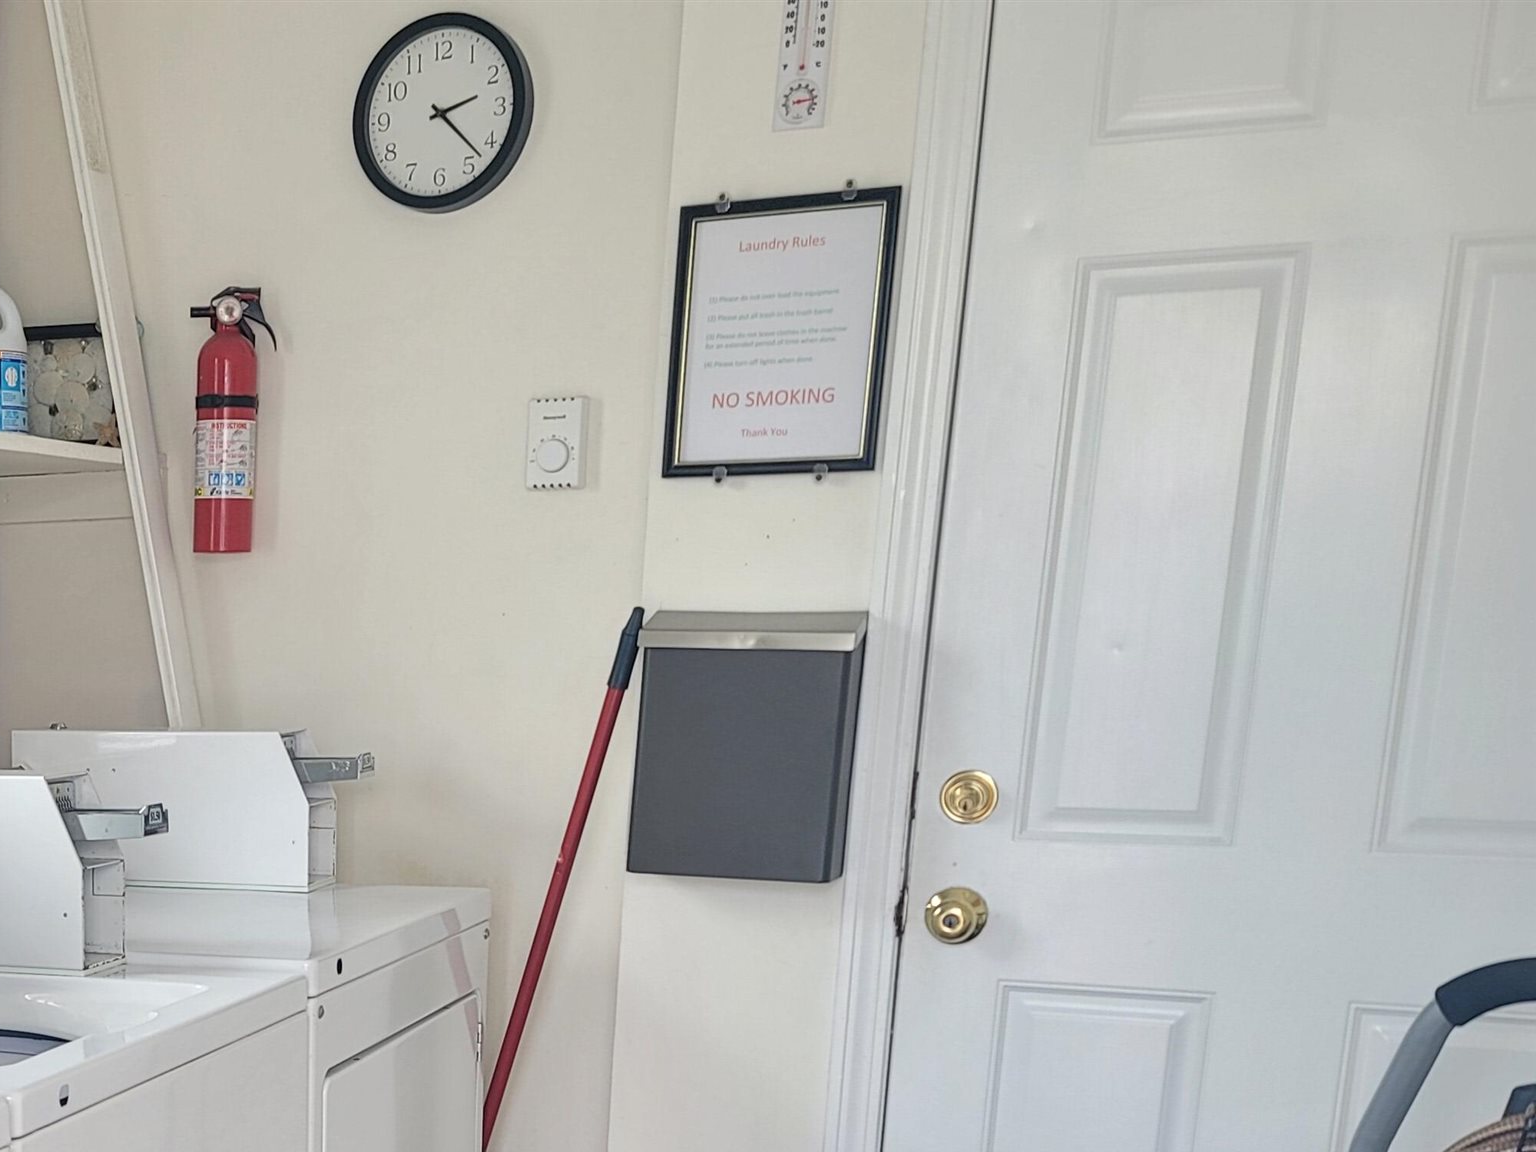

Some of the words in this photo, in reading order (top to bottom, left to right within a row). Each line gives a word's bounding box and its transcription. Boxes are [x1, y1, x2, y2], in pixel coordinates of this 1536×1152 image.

[435, 40, 453, 61] 12
[407, 53, 422, 75] 11
[487, 65, 499, 85] 2
[387, 81, 407, 102] 10
[493, 96, 506, 116] 3
[377, 112, 390, 132] 9
[484, 130, 497, 148] 4
[384, 143, 396, 161] 8
[405, 163, 417, 181] 7
[462, 156, 475, 174] 5
[433, 168, 446, 186] 6
[739, 238, 788, 252] Laundry
[792, 235, 826, 248] Rules
[712, 392, 740, 409] NO
[745, 387, 835, 407] SMOKING
[741, 428, 768, 437] Thank
[770, 427, 789, 437] You
